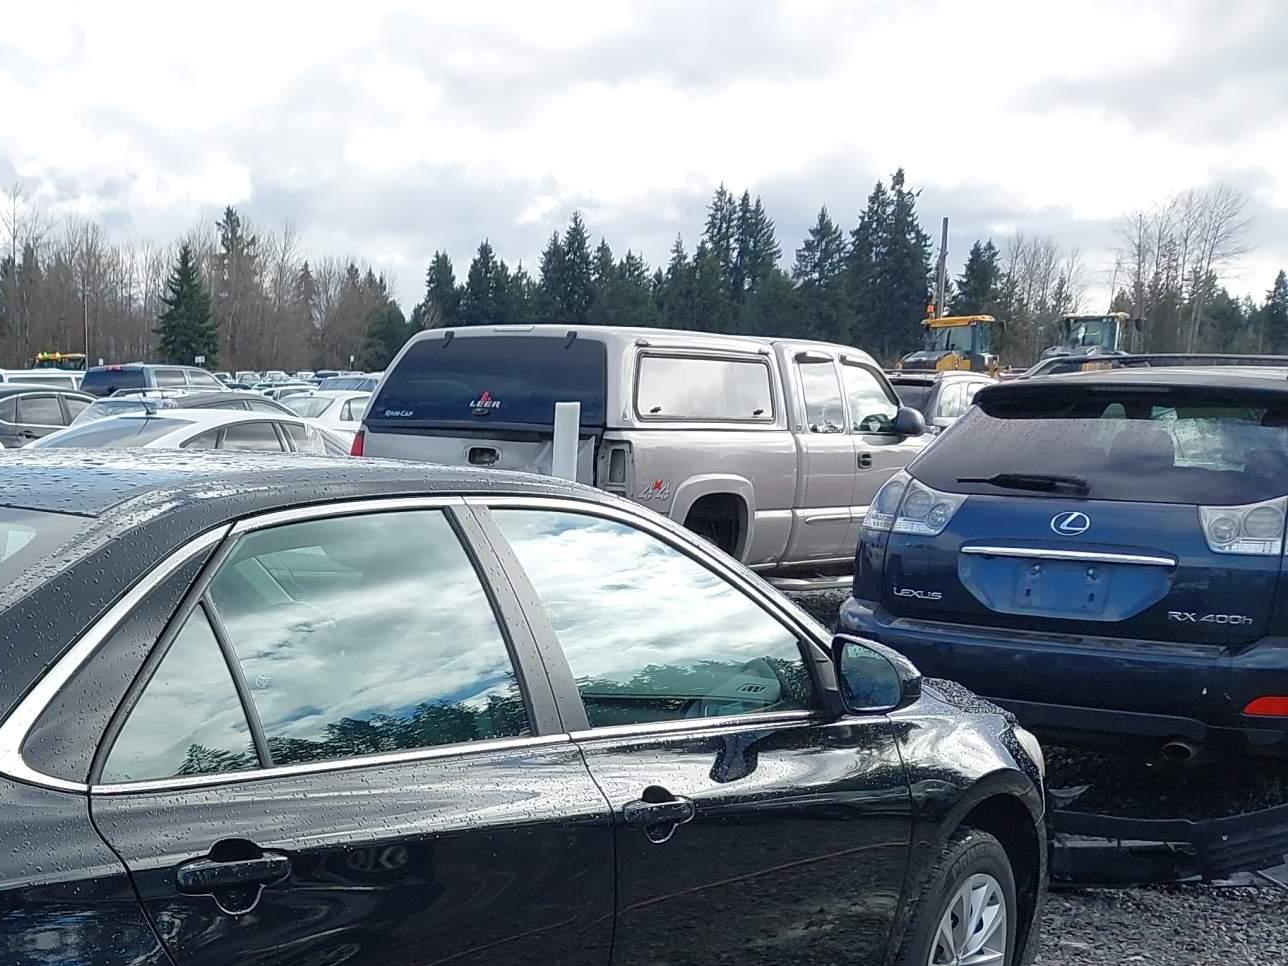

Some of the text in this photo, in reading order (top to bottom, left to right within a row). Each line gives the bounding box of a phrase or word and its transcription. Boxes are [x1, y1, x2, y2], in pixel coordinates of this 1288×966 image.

[469, 399, 501, 409] LEER
[893, 586, 943, 600] LEXUS
[1167, 611, 1253, 625] RX 400h
